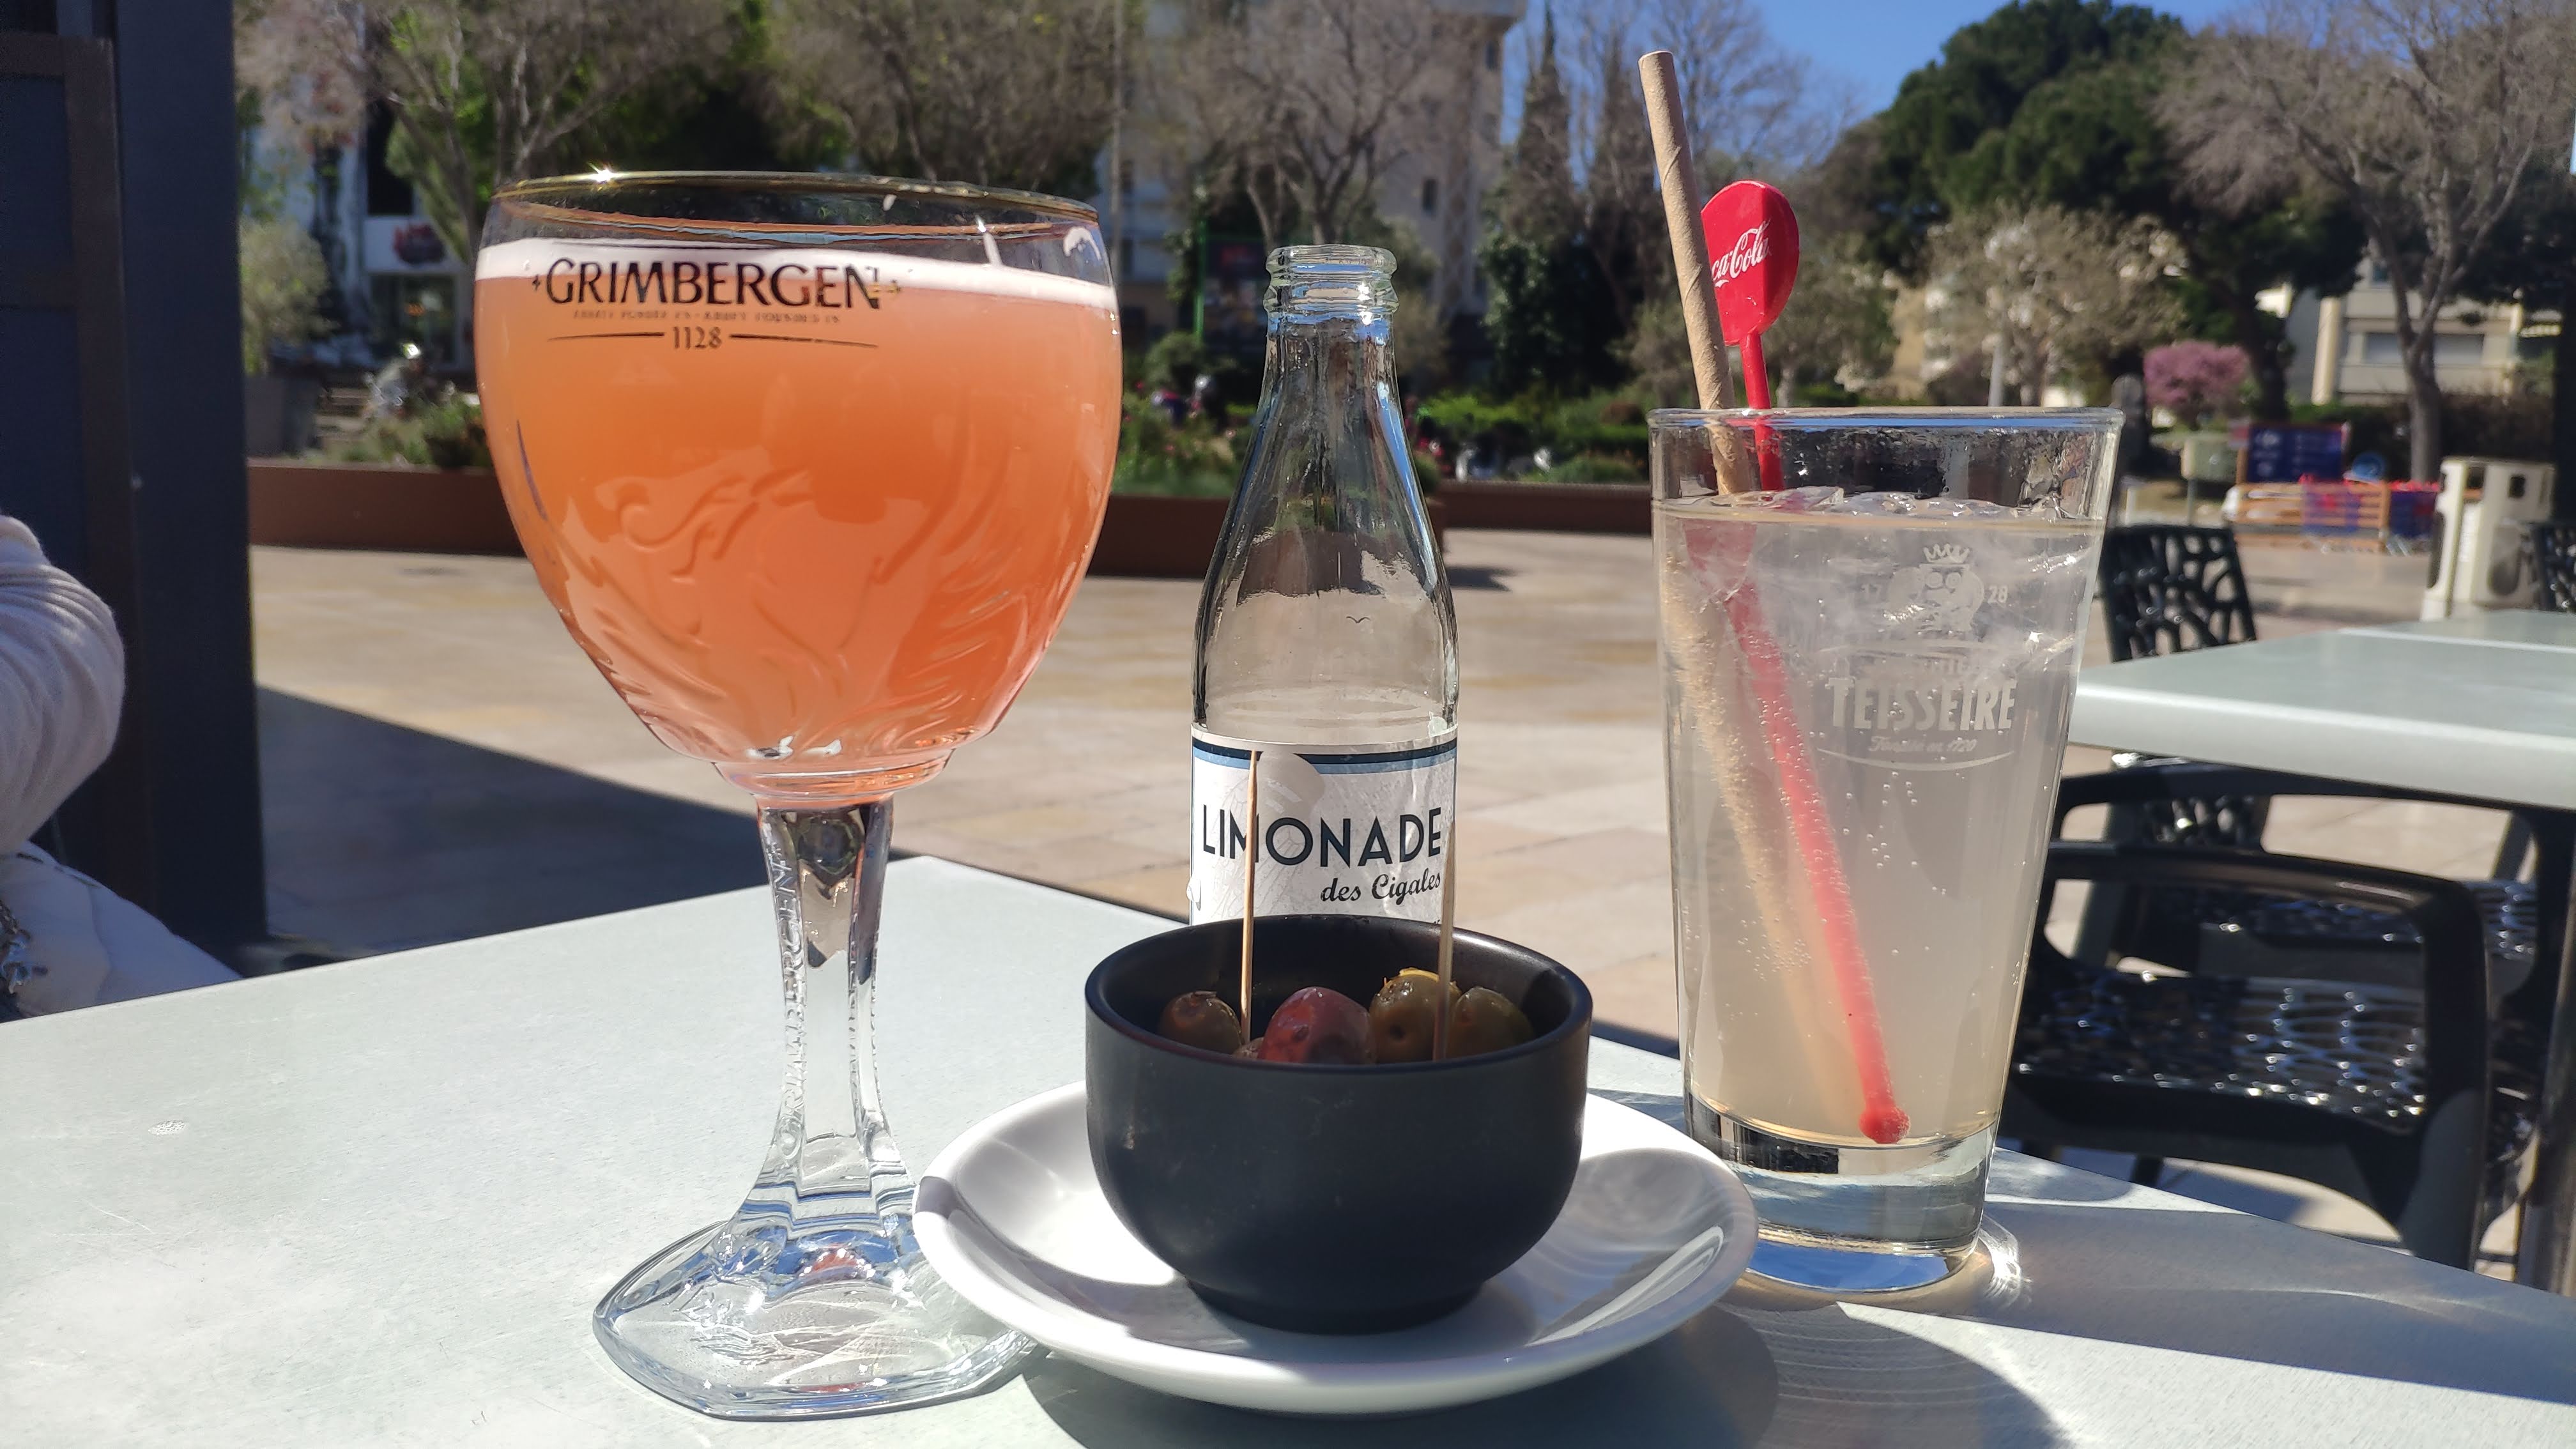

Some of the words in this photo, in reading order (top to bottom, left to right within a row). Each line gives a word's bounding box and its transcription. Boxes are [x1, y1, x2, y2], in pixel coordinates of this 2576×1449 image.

[1712, 219, 1772, 288] ca-Cola
[546, 258, 880, 309] GRIMBERGEN
[672, 326, 722, 349] 1128
[1825, 677, 2018, 731] TEISSEIRE
[1202, 804, 1442, 868] LIMONADE
[1320, 877, 1361, 902] des
[1371, 868, 1441, 905] Cigales
